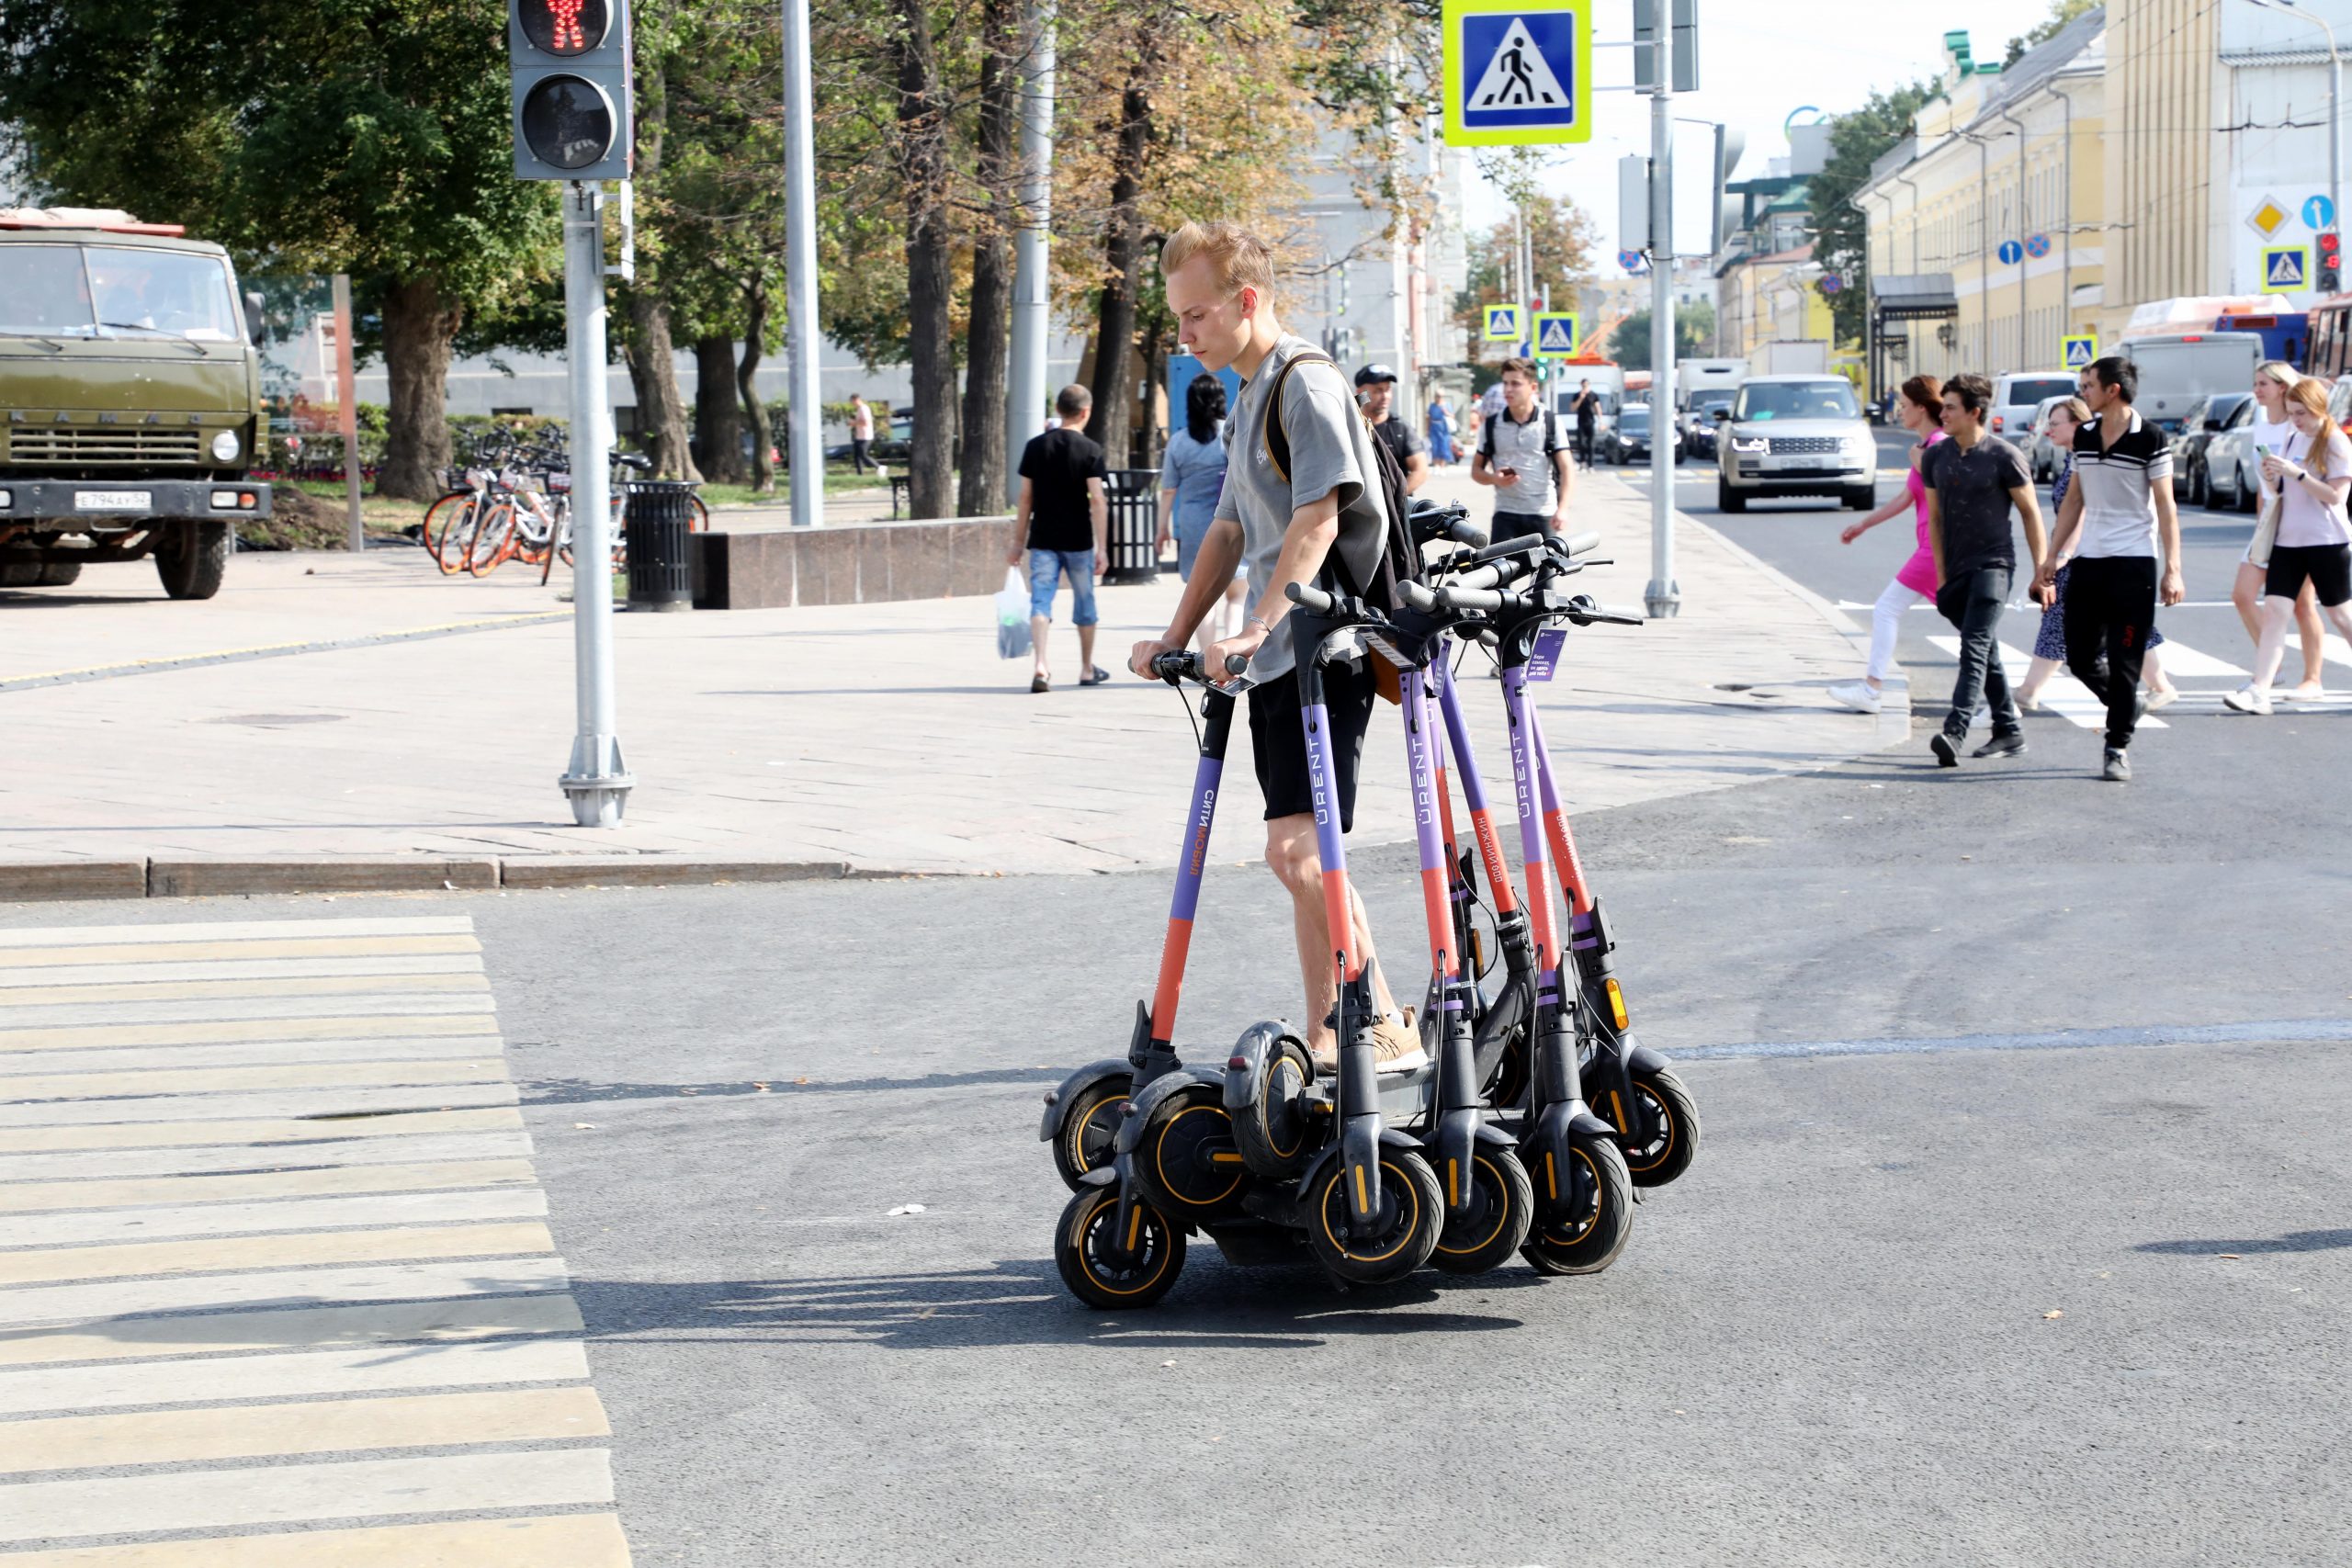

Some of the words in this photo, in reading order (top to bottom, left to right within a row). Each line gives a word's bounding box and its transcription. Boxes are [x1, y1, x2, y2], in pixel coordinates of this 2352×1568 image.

[1308, 738, 1329, 825] ÜRENT
[1412, 739, 1432, 825] ÜRENT
[1512, 732, 1531, 818] ÜRENT
[1477, 817, 1498, 864] НИЖНИЙ
[1491, 864, 1503, 883] 800
